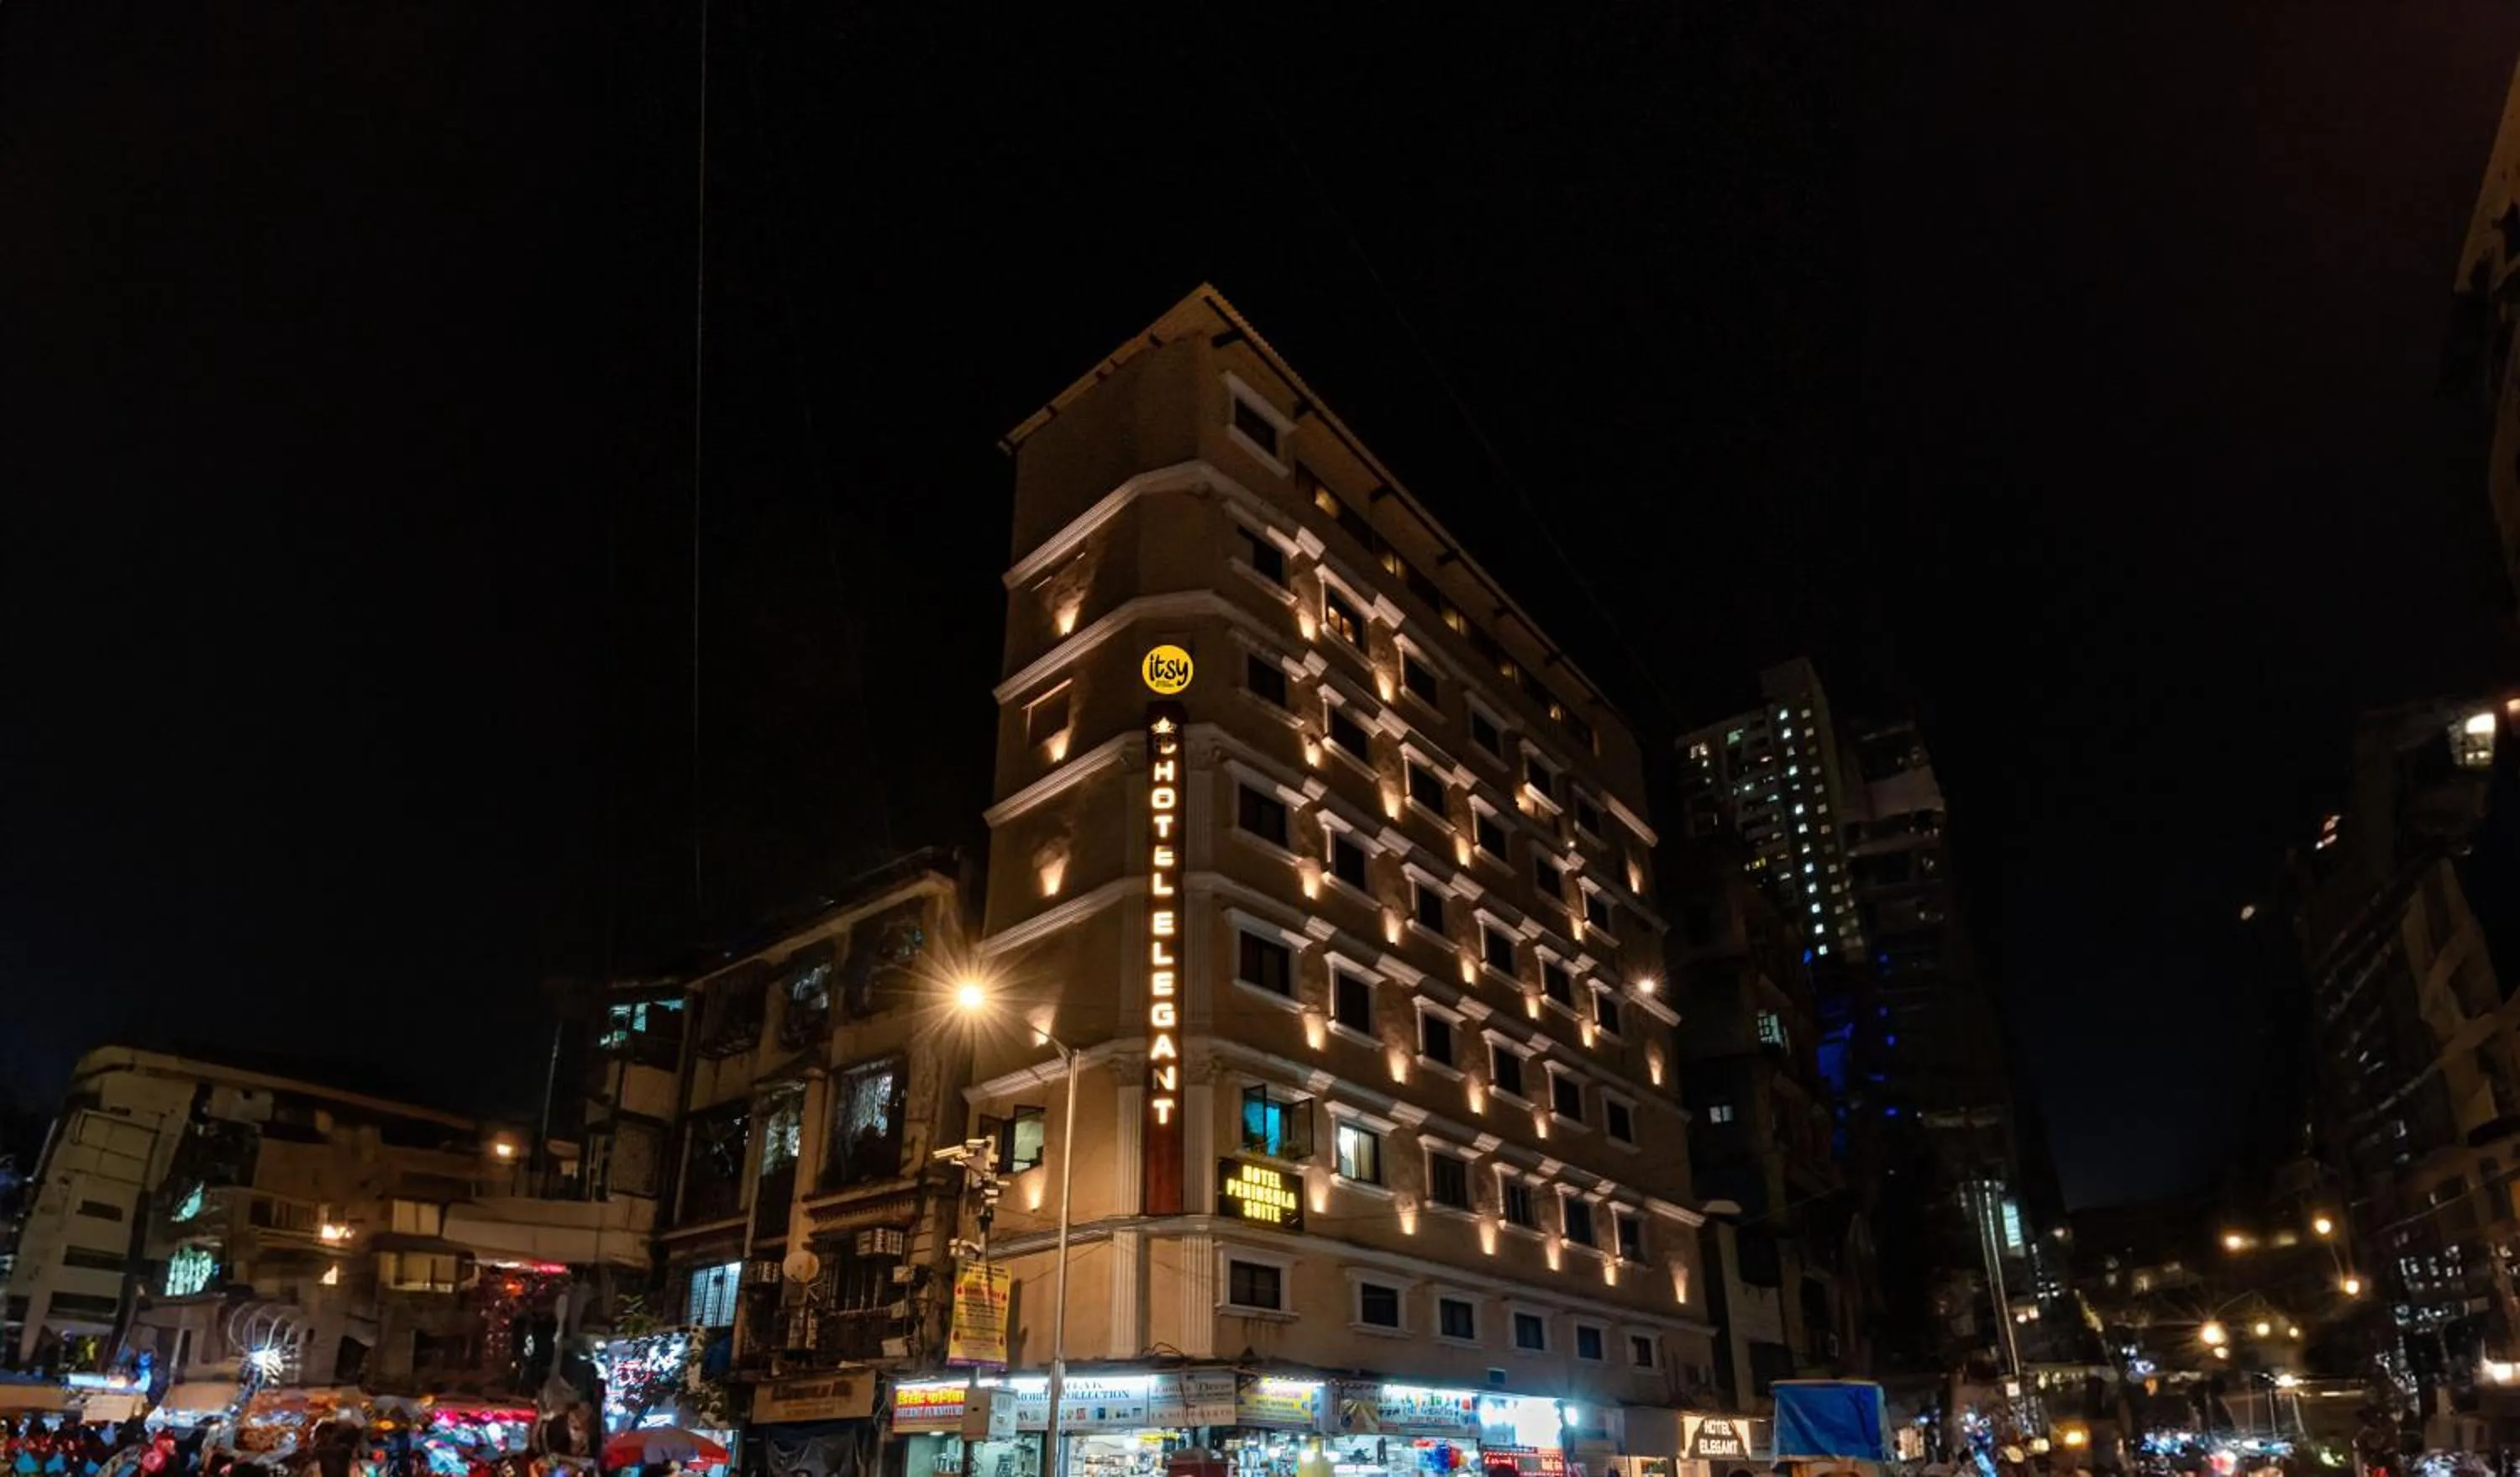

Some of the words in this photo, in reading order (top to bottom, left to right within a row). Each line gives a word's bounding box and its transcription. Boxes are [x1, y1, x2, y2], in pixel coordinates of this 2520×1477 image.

[1149, 654, 1189, 686] itsy
[1151, 760, 1176, 896] HOTEL
[1150, 912, 1176, 1125] ELEGANT
[1242, 1164, 1281, 1189] HOTEL
[1704, 1419, 1732, 1436] HOTEL
[1698, 1438, 1738, 1454] ELEGANT
